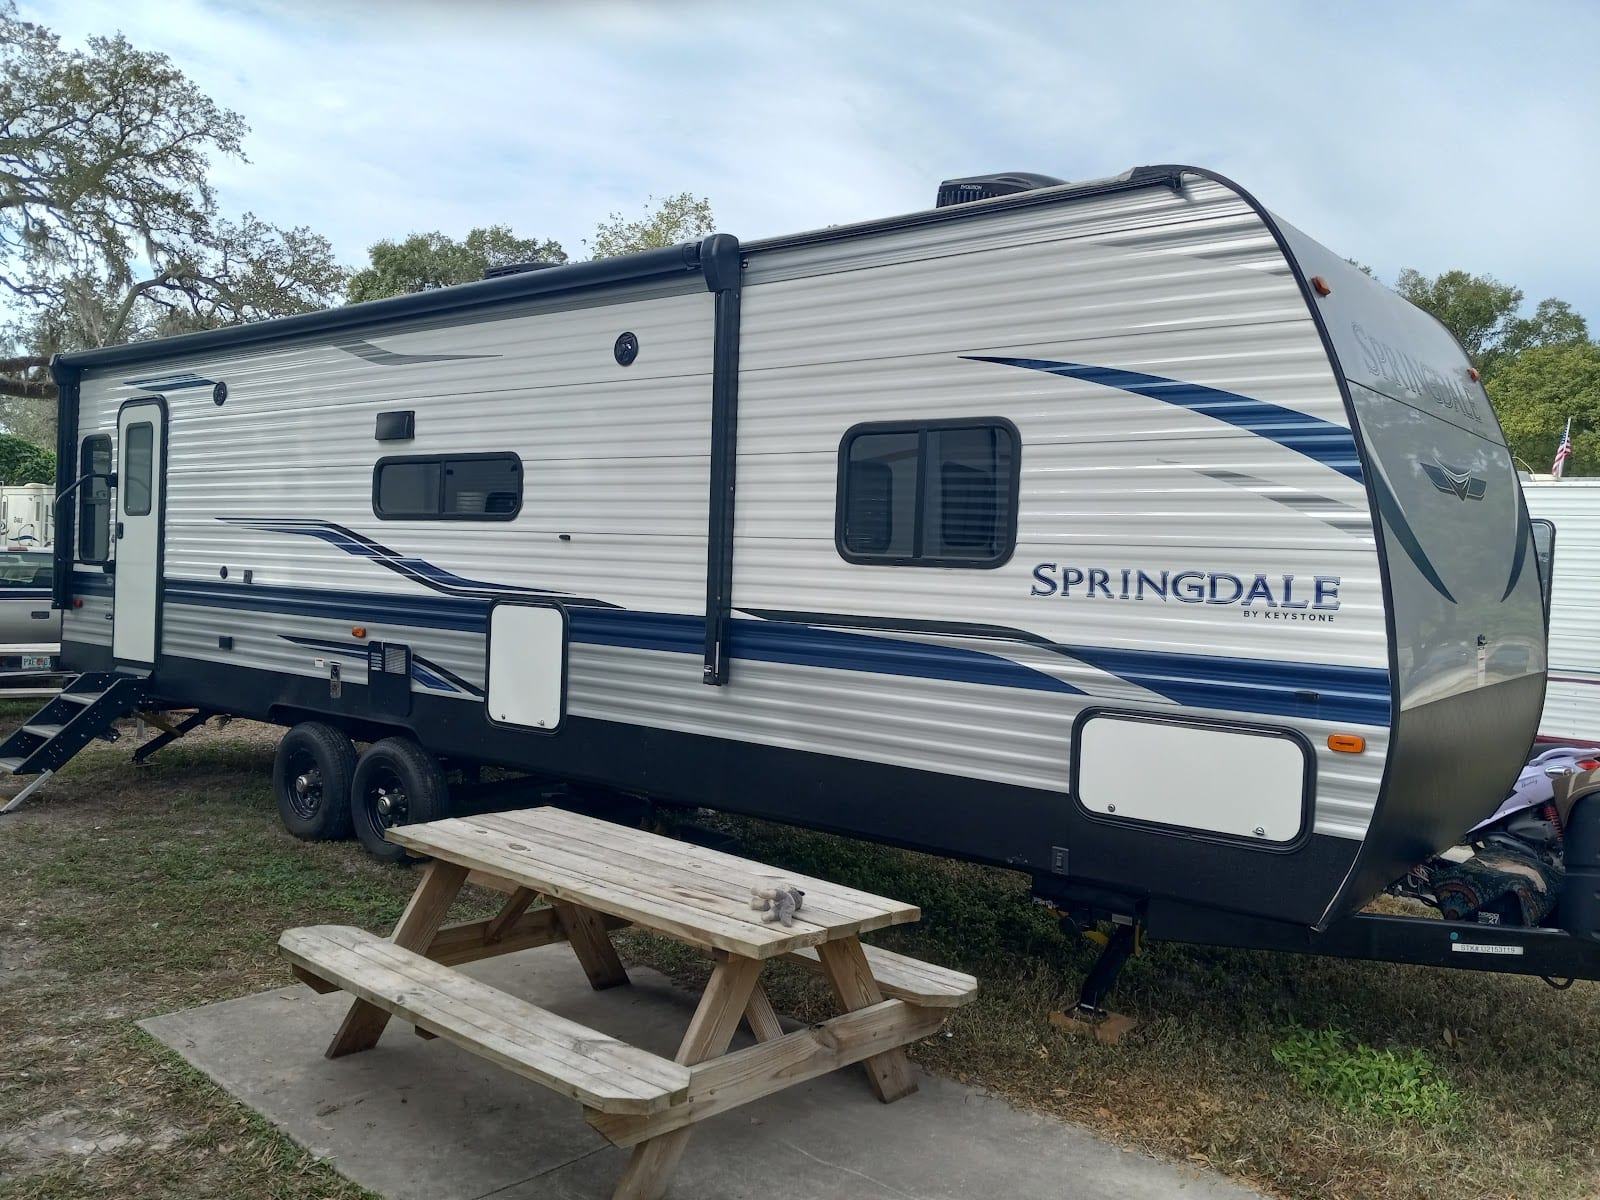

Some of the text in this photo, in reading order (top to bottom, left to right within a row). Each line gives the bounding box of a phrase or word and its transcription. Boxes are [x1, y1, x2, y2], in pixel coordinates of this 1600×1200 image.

[1351, 321, 1483, 423] SPRINGDALE
[1030, 562, 1341, 610] SPRINGDALE
[1243, 610, 1334, 622] BY KEYSTONE
